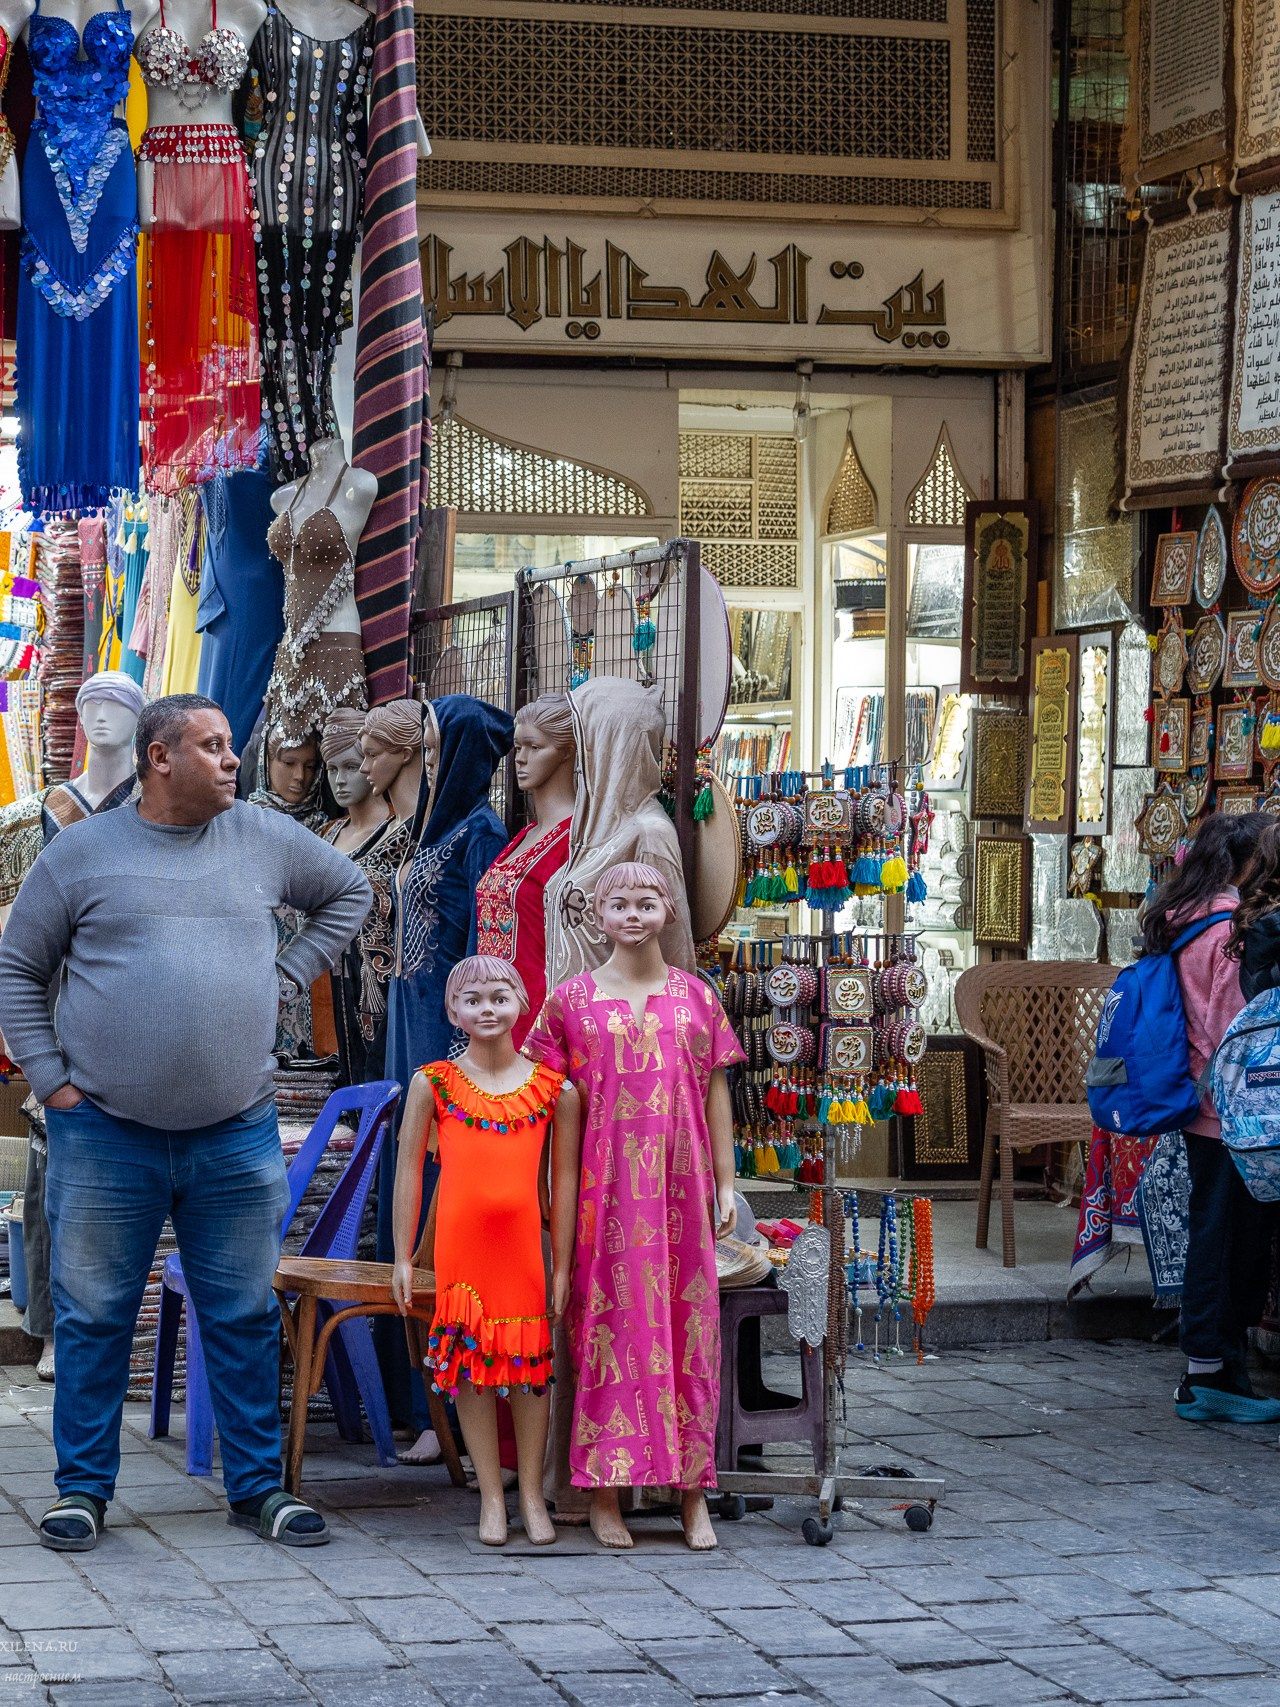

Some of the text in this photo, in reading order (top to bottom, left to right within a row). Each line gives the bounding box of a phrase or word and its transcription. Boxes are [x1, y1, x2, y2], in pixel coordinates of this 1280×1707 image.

[418, 233, 950, 348] بيت الهدايا الاسلا
